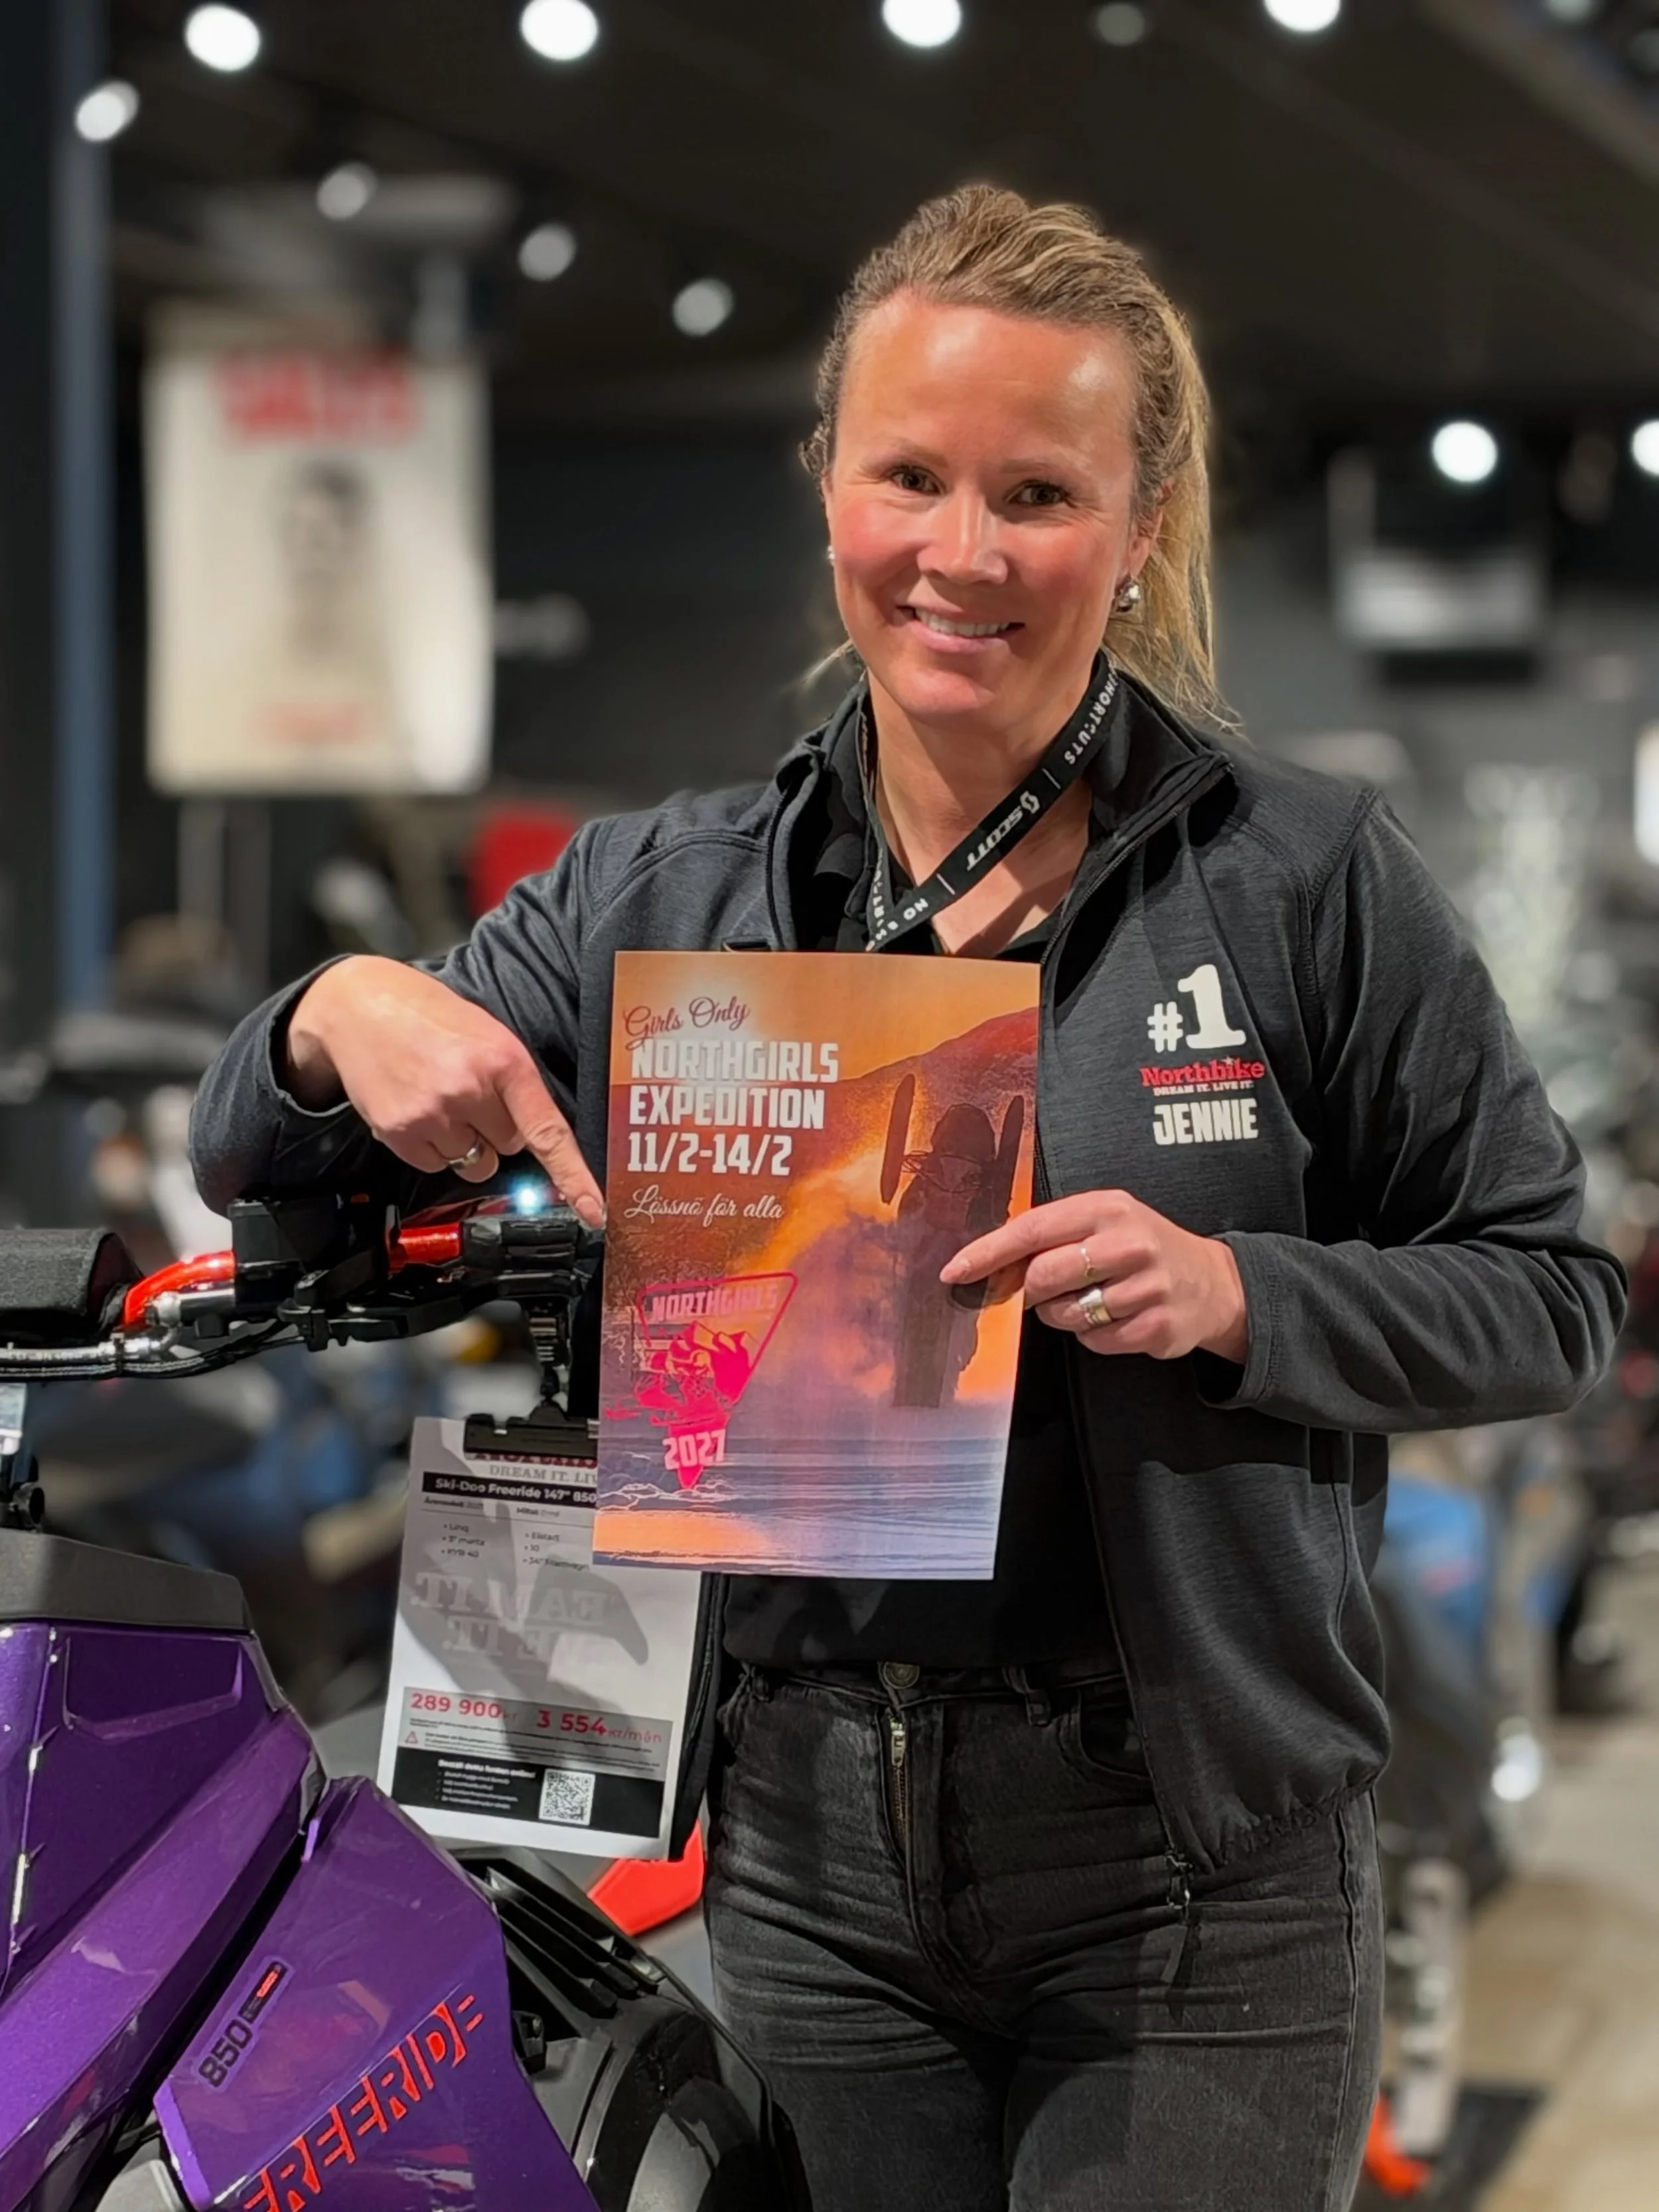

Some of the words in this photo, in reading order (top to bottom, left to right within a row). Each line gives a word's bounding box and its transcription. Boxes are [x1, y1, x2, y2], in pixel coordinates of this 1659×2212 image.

[967, 804, 1023, 871] SCOTT
[622, 1005, 684, 1051] Girls
[689, 996, 750, 1031] Only
[1147, 964, 1246, 1053] #1
[630, 1037, 839, 1083] NORTHGIRLS
[1139, 1057, 1265, 1086] Northbike
[628, 1084, 826, 1130] EXPEDITION
[1153, 1098, 1258, 1145] JENNIE
[626, 1131, 793, 1176] 11/2-14/2
[703, 1193, 738, 1227] för
[743, 1195, 785, 1219] alla
[662, 1428, 726, 1470] 2027
[435, 1477, 486, 1493] Ski-Doo
[488, 1483, 541, 1499] Freeride
[488, 1464, 546, 1481] DREAM
[411, 1693, 451, 1712] 289
[536, 1708, 551, 1729] 3
[198, 2020, 253, 2089] 850
